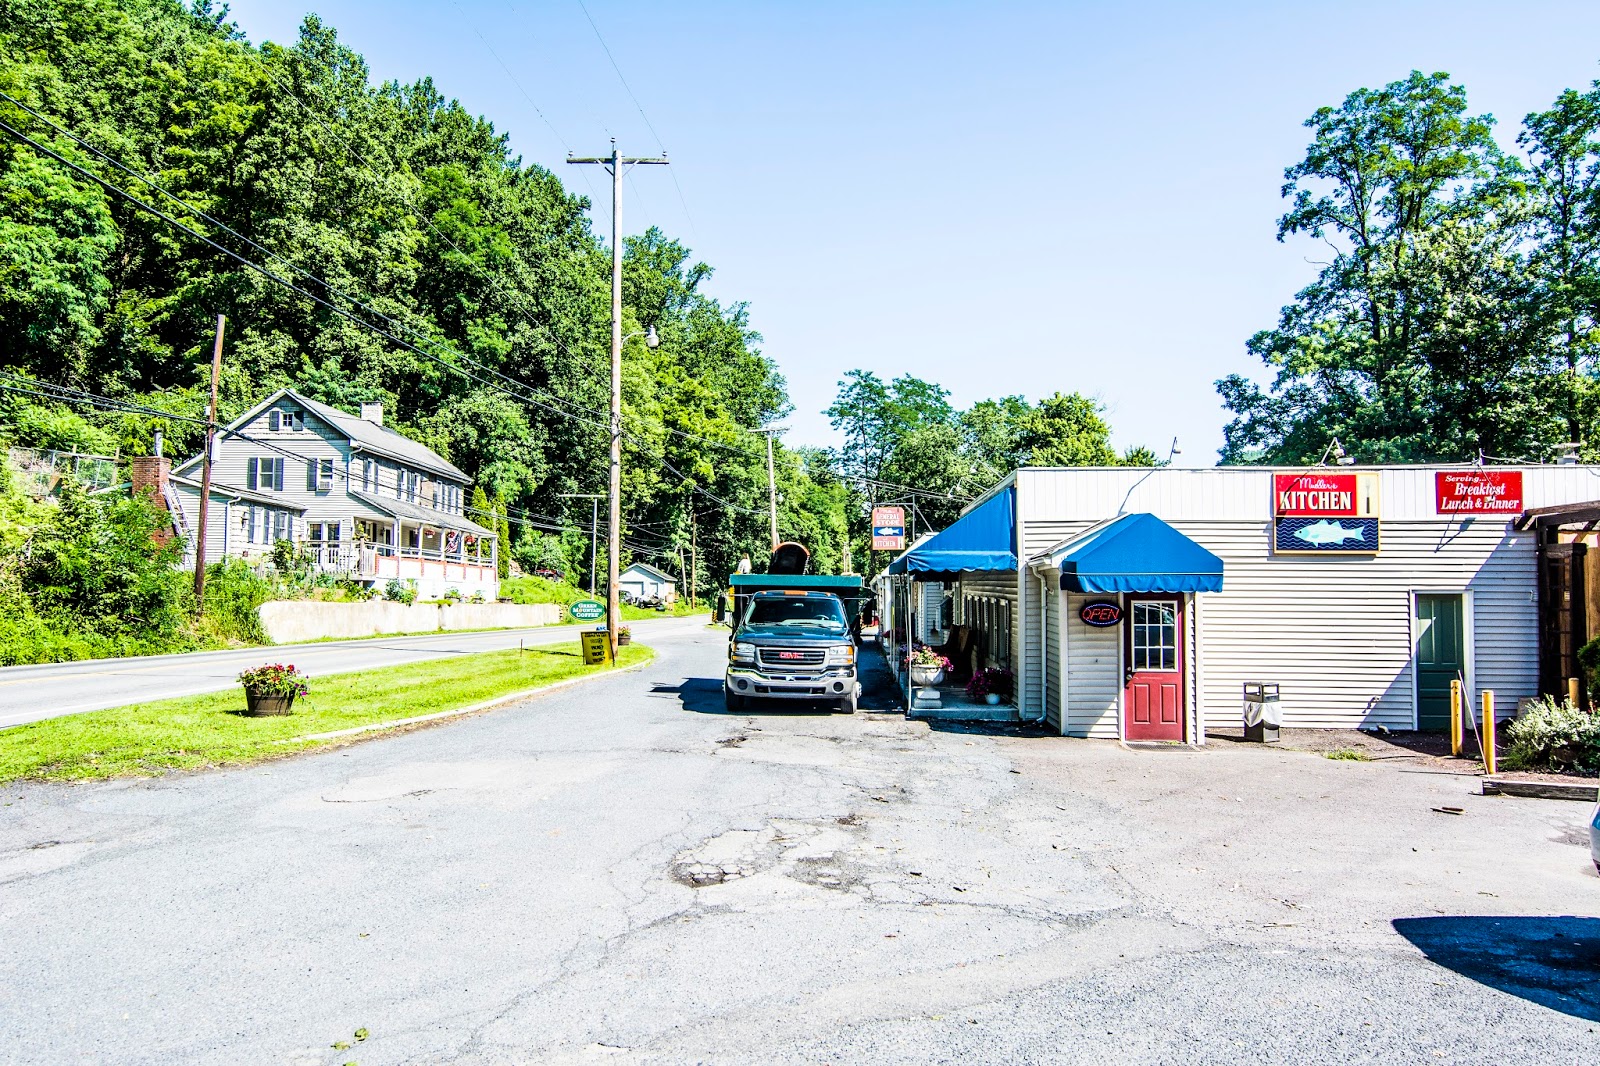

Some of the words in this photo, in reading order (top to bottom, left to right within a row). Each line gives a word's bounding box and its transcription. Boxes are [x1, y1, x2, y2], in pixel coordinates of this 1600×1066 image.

[1454, 482, 1506, 496] Breakfast
[1280, 491, 1352, 510] KITCHEN
[1441, 496, 1474, 510] Lunch
[1475, 498, 1482, 508] &
[1483, 497, 1519, 510] Dinner
[1082, 608, 1120, 620] OPEN
[779, 651, 804, 659] GMC
